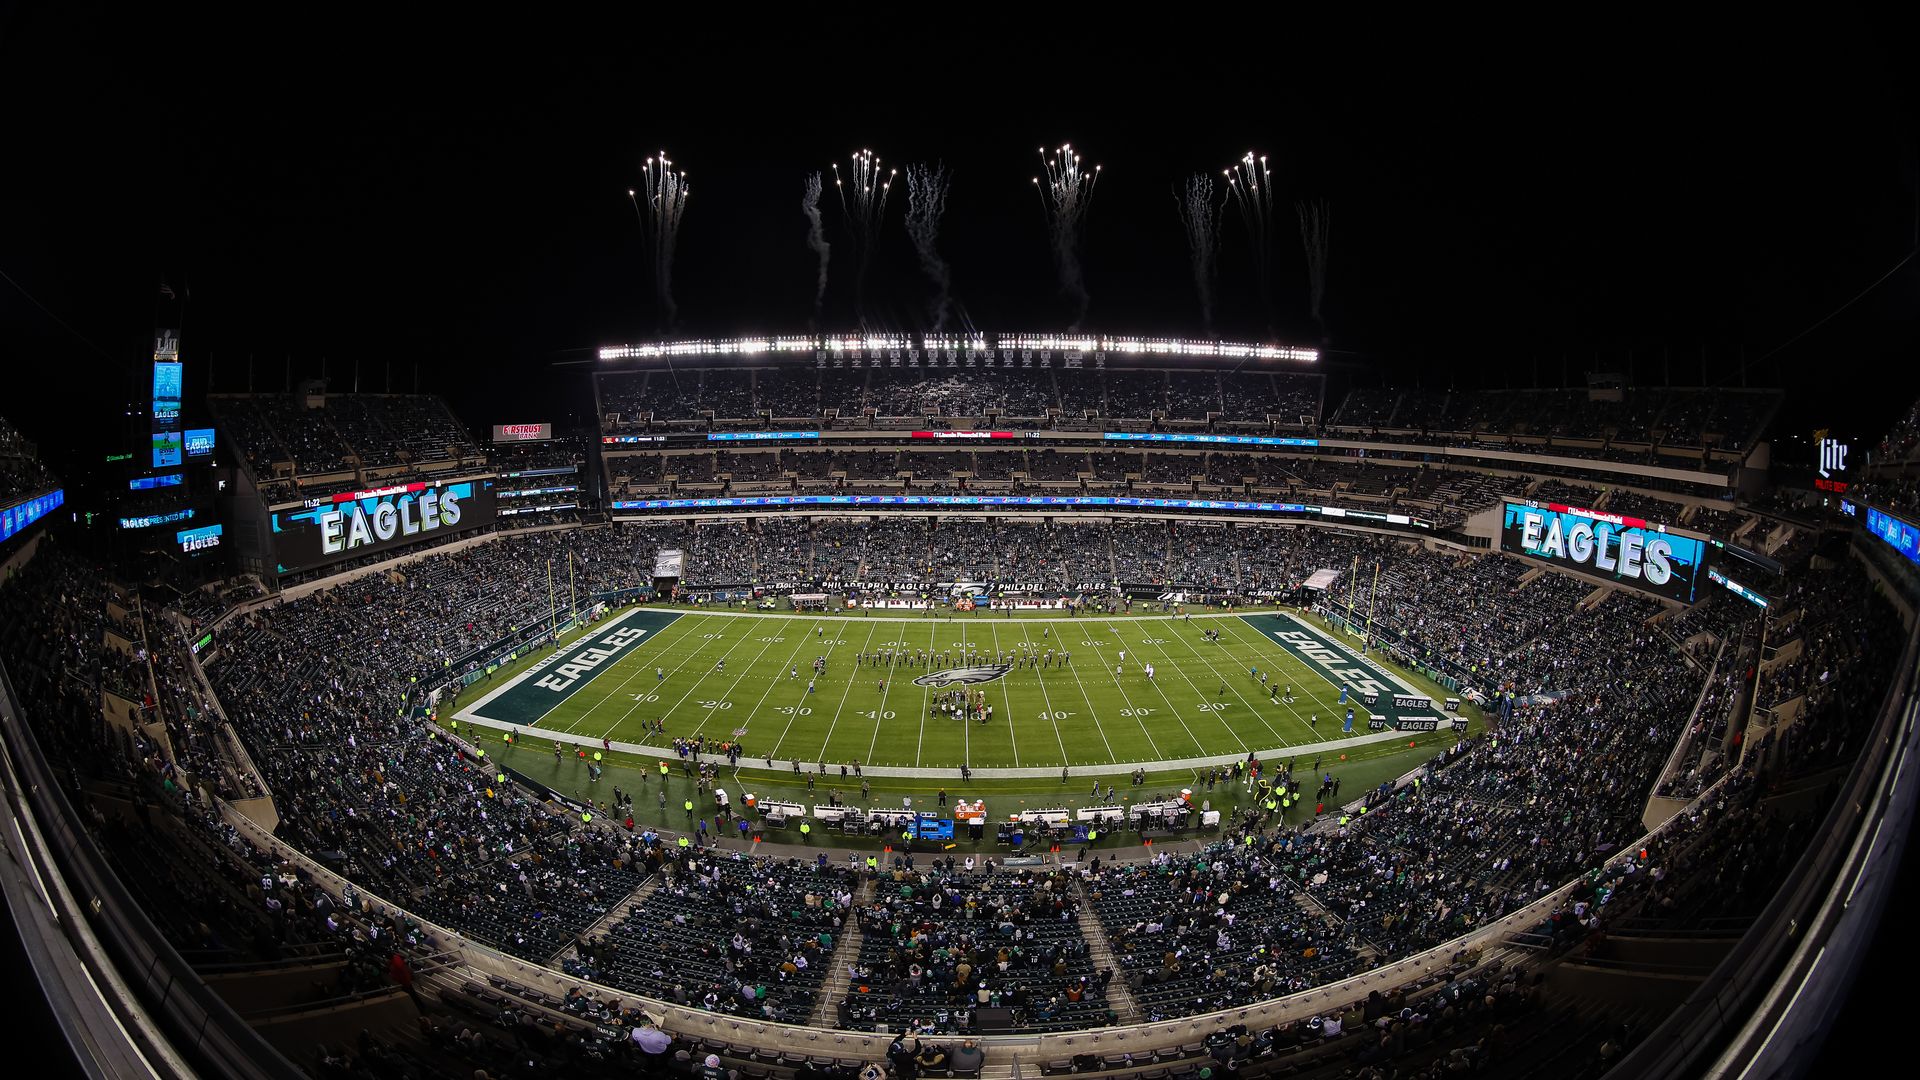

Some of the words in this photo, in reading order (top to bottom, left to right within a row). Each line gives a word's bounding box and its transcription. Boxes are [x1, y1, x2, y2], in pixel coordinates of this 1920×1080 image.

[154, 410, 179, 419] EAGLES
[1819, 438, 1848, 479] Lite
[303, 498, 320, 508] 11:22
[320, 490, 461, 555] EAGLES
[1521, 511, 1672, 585] EAGLES
[893, 583, 931, 591] EAGLES
[532, 626, 647, 692] EAGLES
[1273, 630, 1391, 694] EAGLES
[634, 692, 660, 703] 10
[703, 700, 733, 710] 20
[1196, 702, 1225, 712] 20
[1364, 696, 1377, 705] FLY
[1395, 698, 1429, 709] EAGLES
[1446, 702, 1458, 711] FLY
[780, 706, 813, 716] 30
[864, 710, 896, 720] 40
[1038, 710, 1069, 720] 40
[1119, 706, 1151, 717] 30
[1370, 720, 1384, 729] FLY
[1400, 720, 1435, 730] EAGLES
[1454, 722, 1467, 731] FLY
